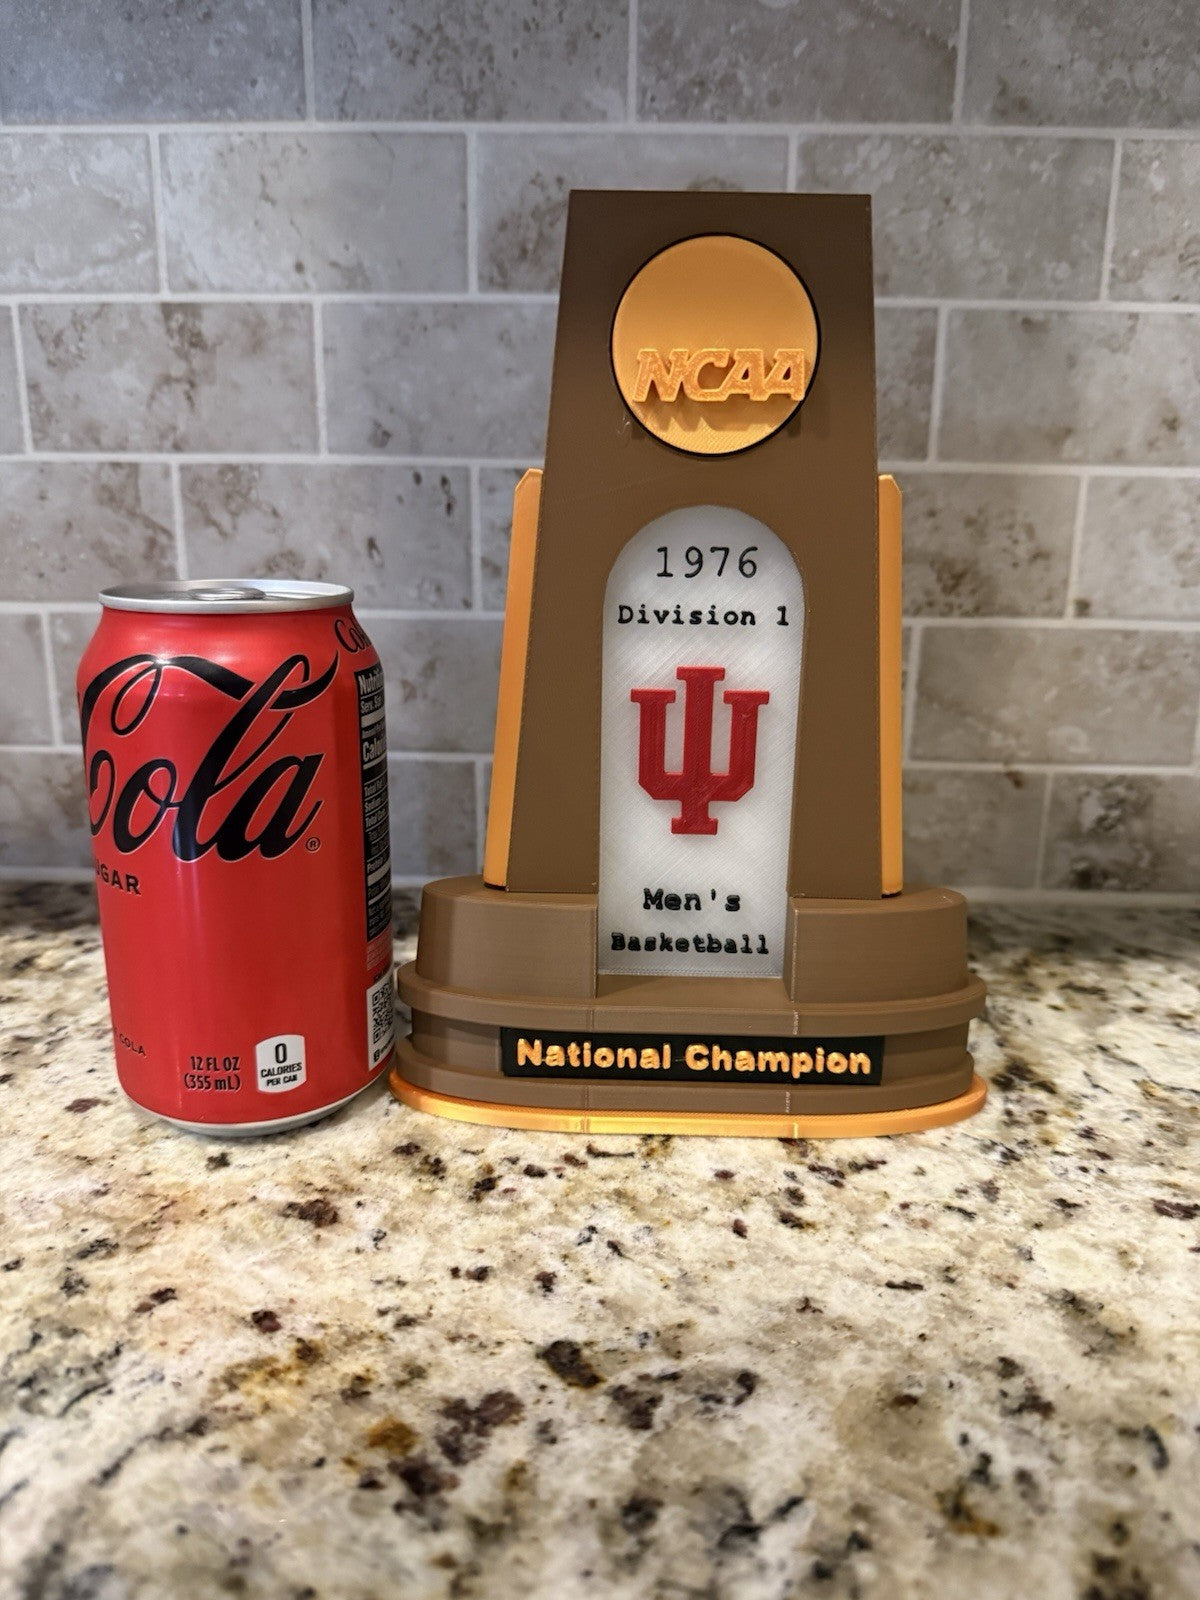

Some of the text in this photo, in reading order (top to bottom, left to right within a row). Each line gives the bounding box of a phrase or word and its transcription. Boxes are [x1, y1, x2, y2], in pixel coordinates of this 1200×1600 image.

[632, 348, 805, 402] NCAA
[655, 546, 758, 578] 1976
[617, 604, 789, 626] Division 1
[643, 888, 741, 911] Men's
[611, 932, 769, 955] Basketball
[119, 1033, 146, 1056] COLA
[274, 1042, 288, 1064] 0
[190, 1056, 241, 1072] 12 FL OZ
[516, 1038, 872, 1079] National Champion
[260, 1062, 303, 1079] CALORIES
[266, 1076, 281, 1087] PER
[184, 1074, 242, 1092] (355 mL)
